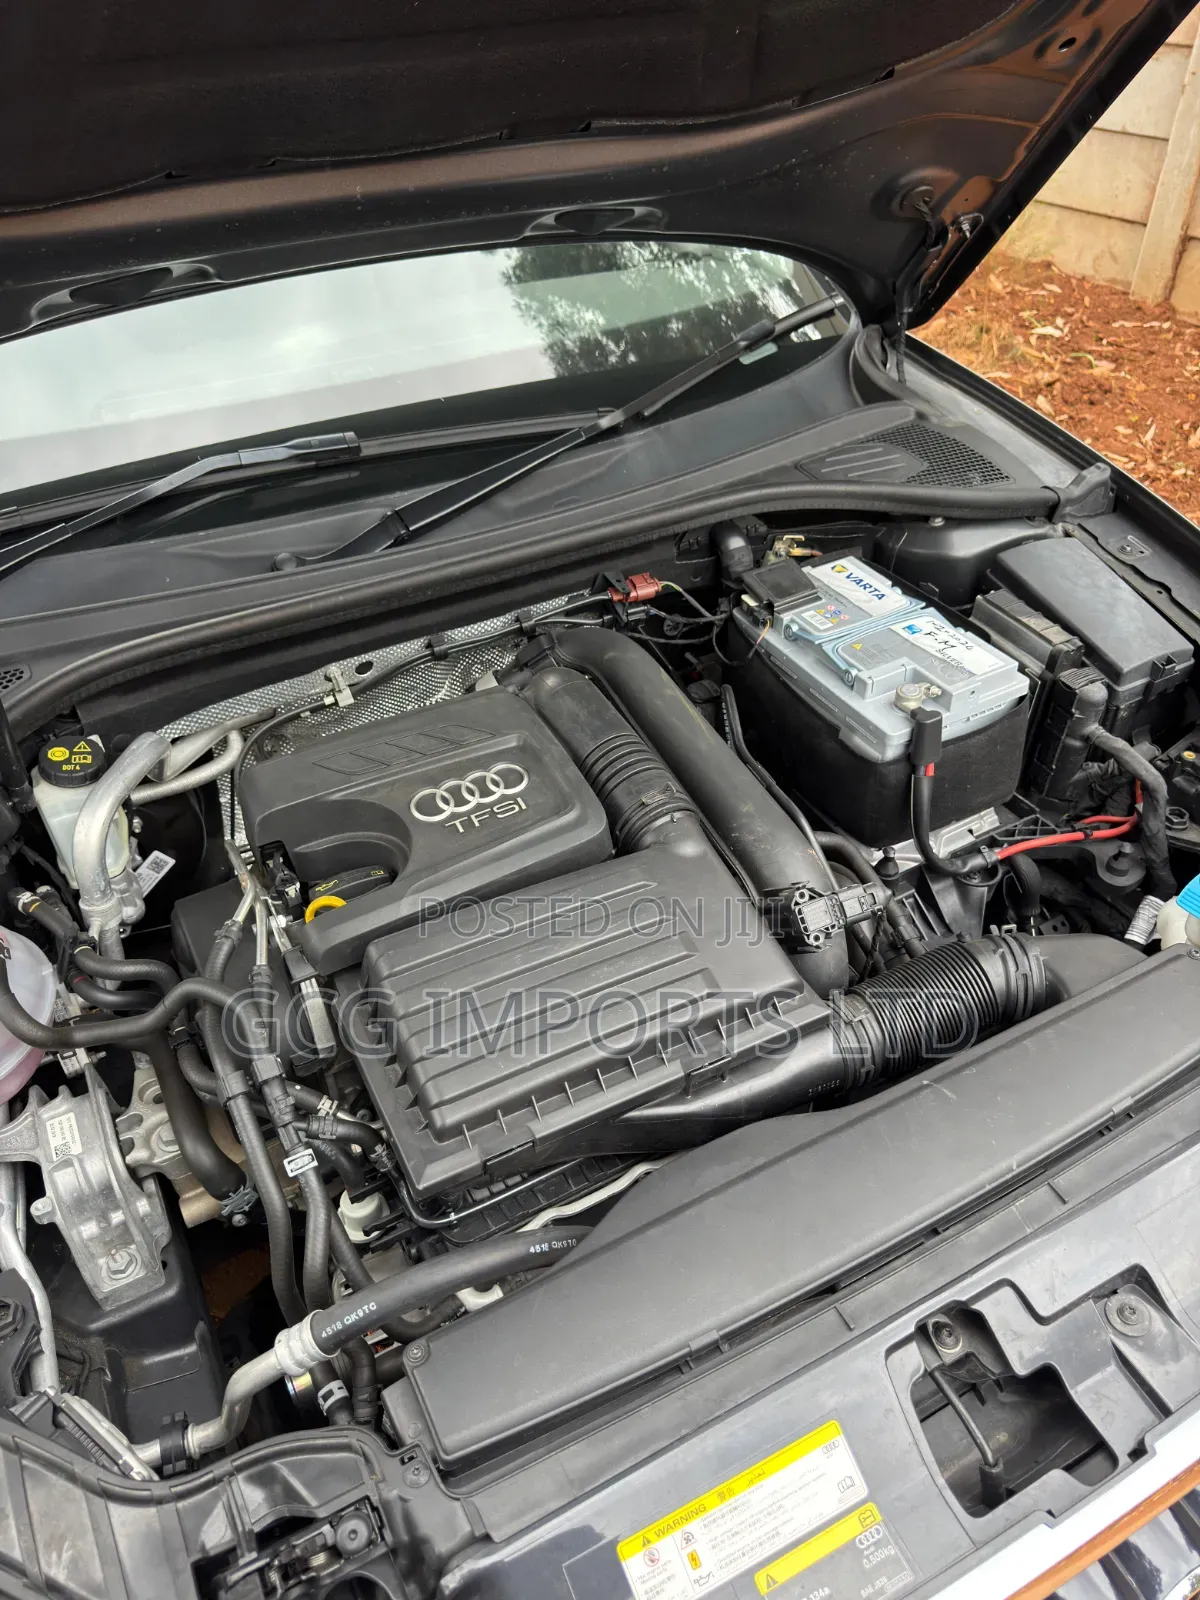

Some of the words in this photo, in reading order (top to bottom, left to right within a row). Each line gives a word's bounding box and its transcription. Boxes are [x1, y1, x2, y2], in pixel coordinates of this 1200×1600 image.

[845, 573, 886, 600] VARTA
[445, 797, 527, 833] TFSI
[321, 1320, 342, 1338] 4518
[654, 1503, 707, 1539] WARNING
